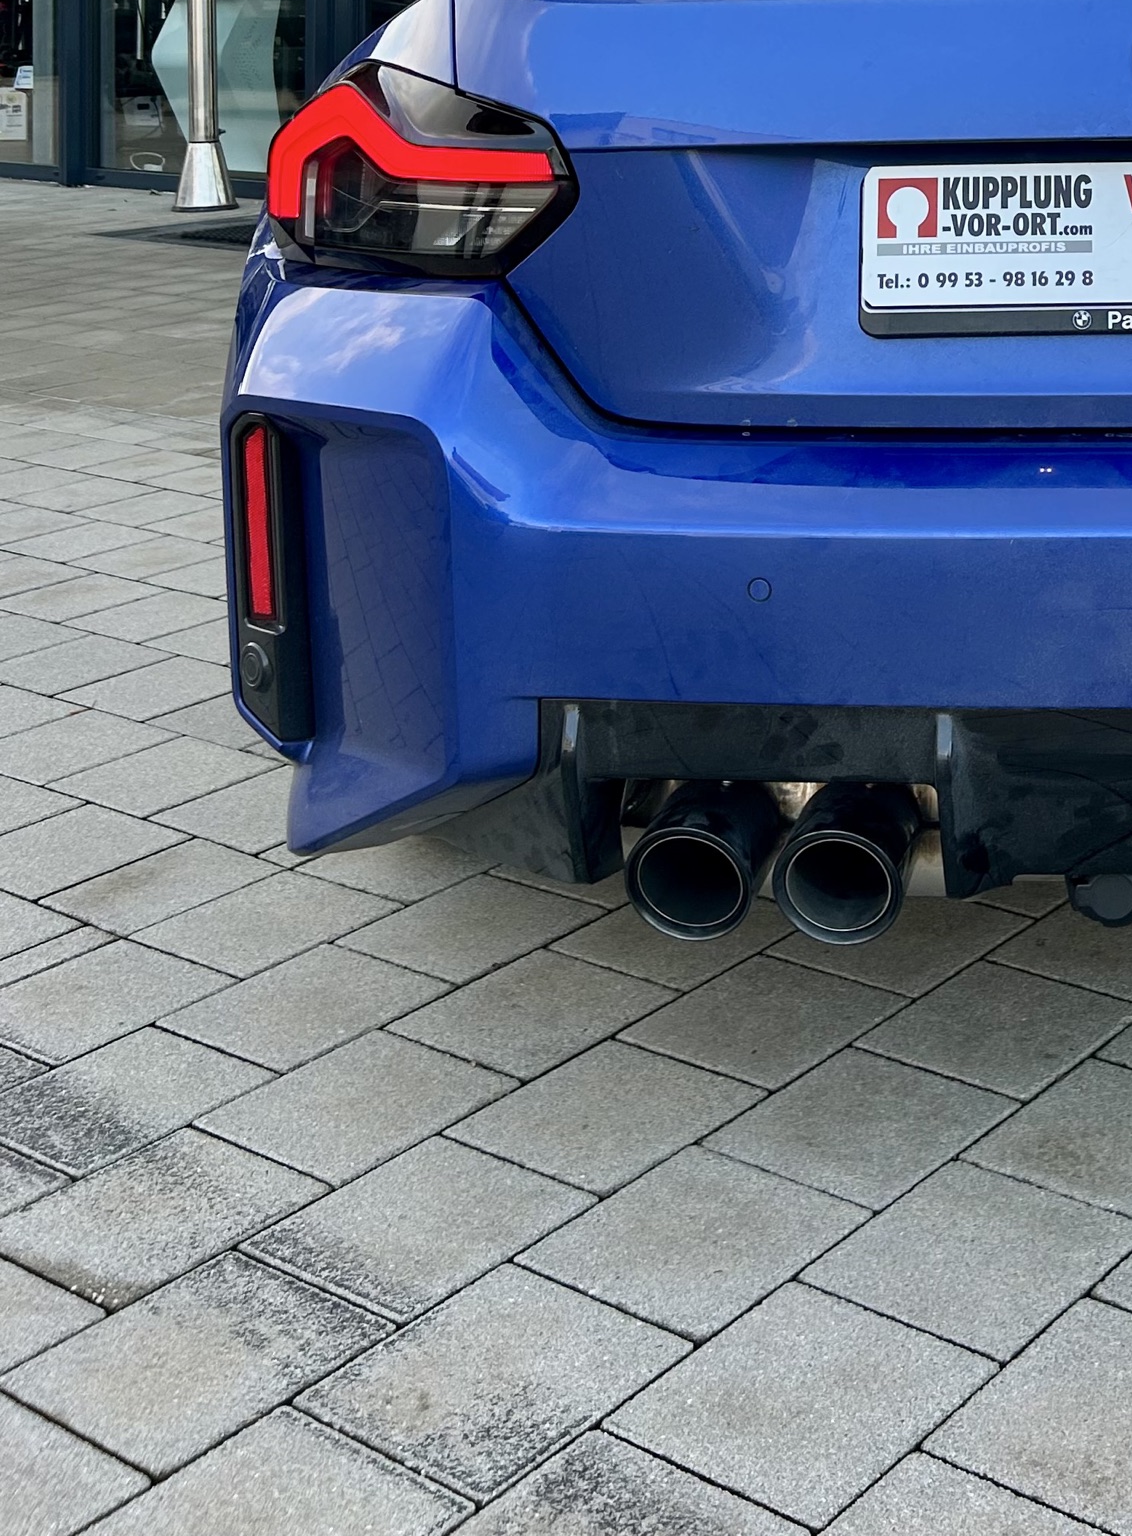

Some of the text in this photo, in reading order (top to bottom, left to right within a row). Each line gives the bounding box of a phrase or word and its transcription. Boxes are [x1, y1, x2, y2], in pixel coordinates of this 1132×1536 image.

[943, 174, 1092, 210] KUPPLUNG
[942, 213, 1093, 237] -VOR-ORT.com
[902, 242, 1066, 254] IHRE EINBAUPROFIS
[877, 273, 911, 289] Tel.:
[917, 273, 929, 288] 0
[936, 272, 958, 288] 99
[964, 272, 983, 288] 53
[1002, 271, 1025, 287] 98
[1031, 271, 1048, 287] 16
[1055, 270, 1075, 286] 29
[1081, 270, 1094, 286] 8
